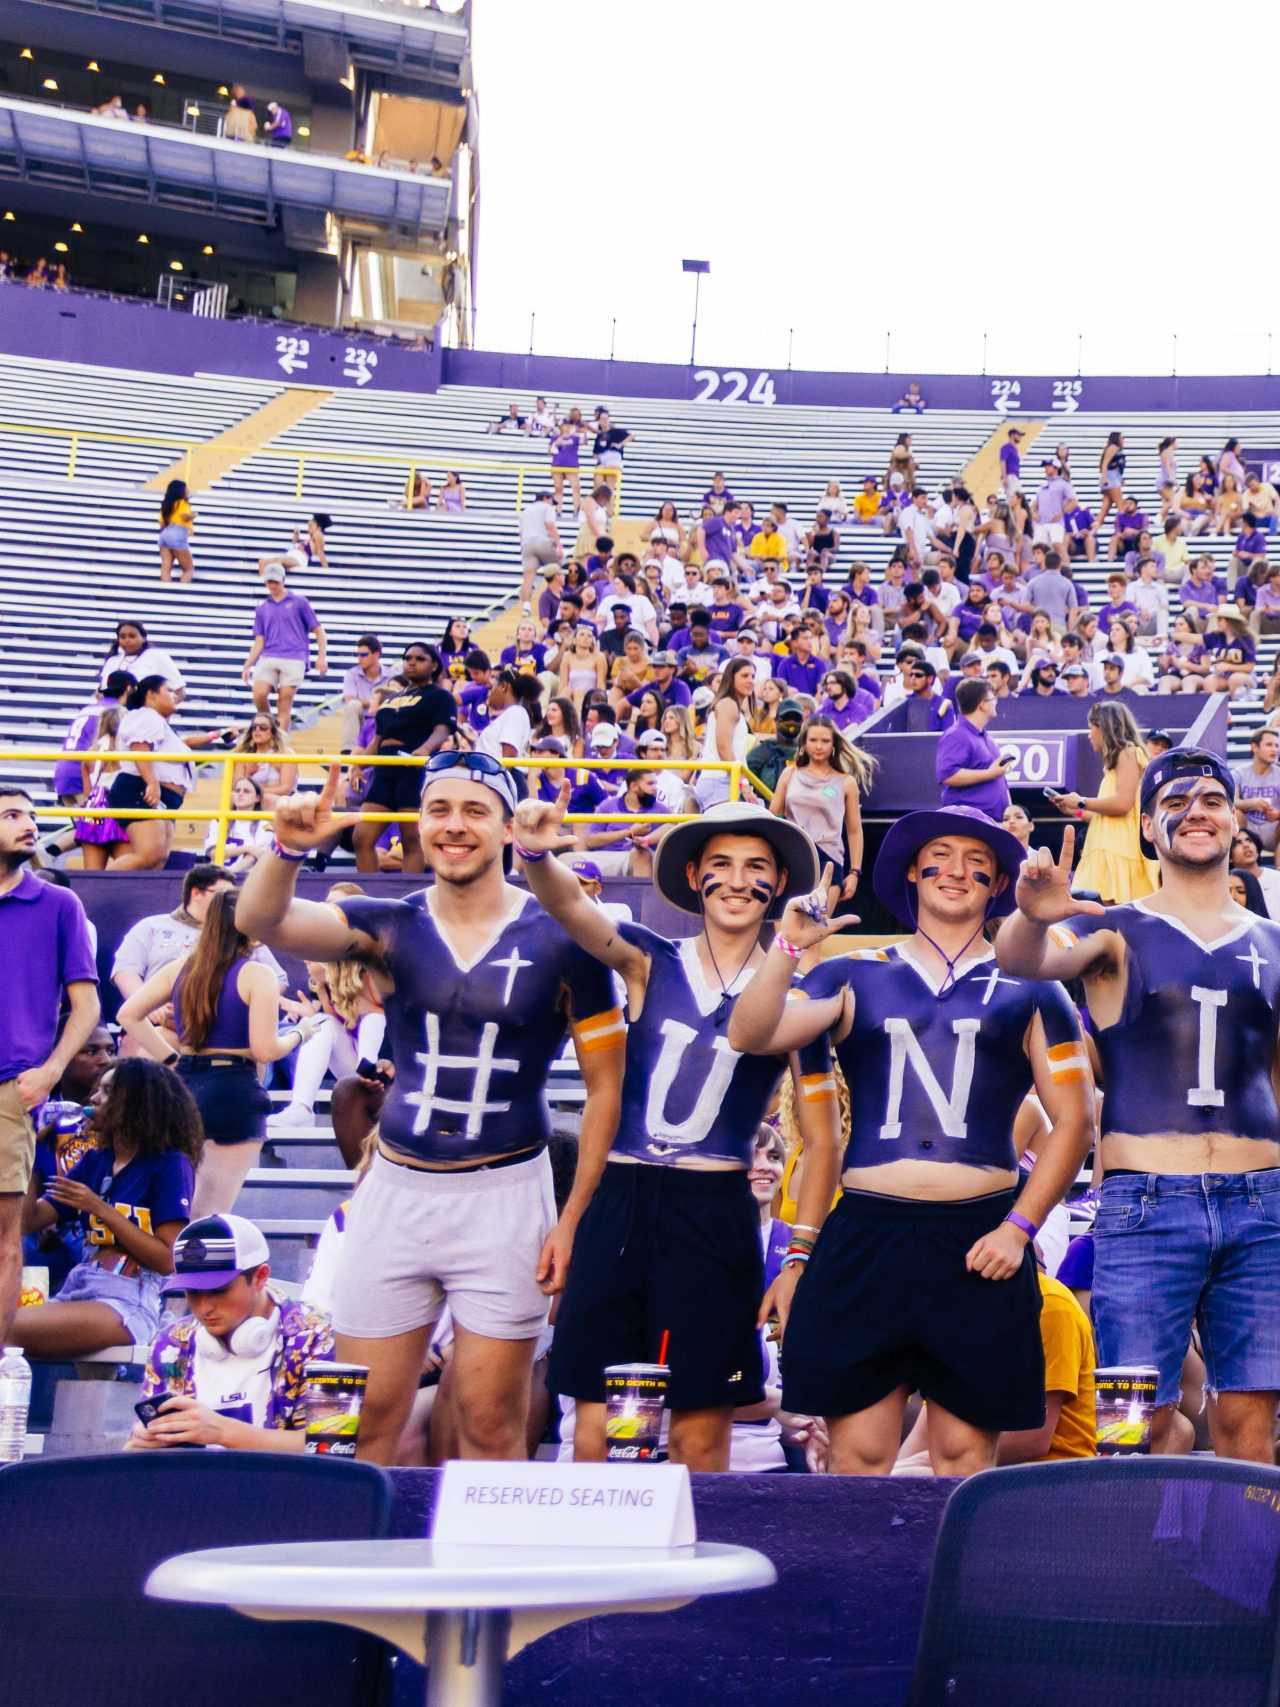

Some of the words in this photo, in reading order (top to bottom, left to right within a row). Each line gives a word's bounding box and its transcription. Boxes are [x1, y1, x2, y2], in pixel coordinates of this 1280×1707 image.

[276, 336, 310, 355] 223
[344, 347, 378, 367] 224
[694, 369, 777, 406] 224
[991, 380, 1021, 395] 224
[1053, 380, 1082, 396] 225
[1187, 985, 1228, 1107] I
[645, 1018, 744, 1144] U
[880, 1018, 982, 1139] N
[221, 1391, 247, 1403] LSU
[464, 1486, 564, 1506] RESERVED
[568, 1488, 655, 1508] SEATING
